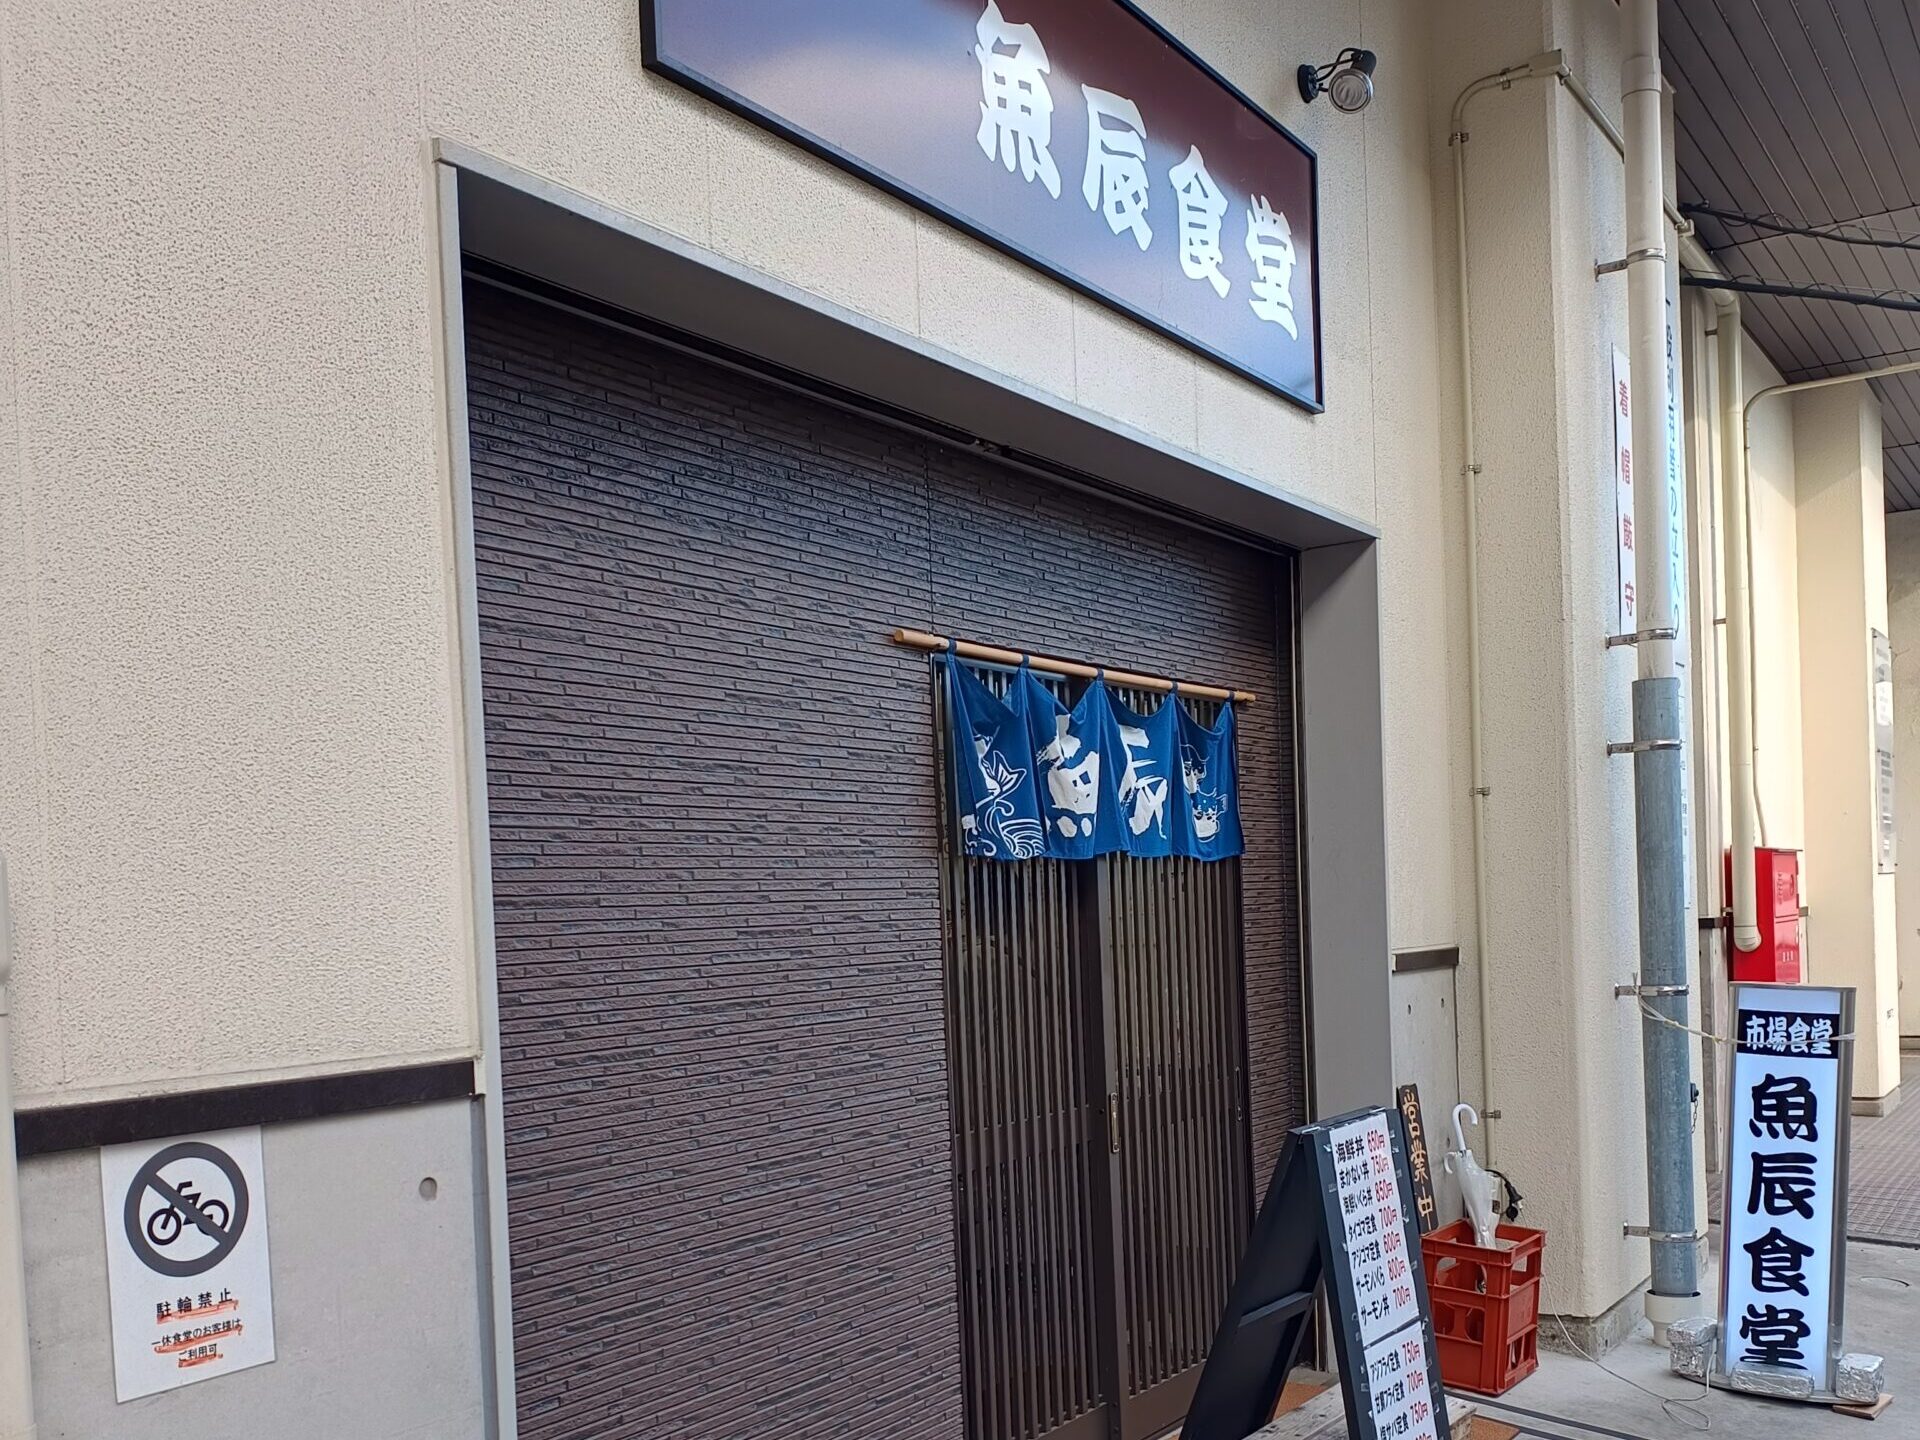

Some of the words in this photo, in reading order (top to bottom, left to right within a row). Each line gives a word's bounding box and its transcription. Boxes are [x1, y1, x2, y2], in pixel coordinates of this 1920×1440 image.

[975, 0, 1298, 340] 魚辰食堂
[1745, 1014, 1834, 1056] 市場食堂
[1335, 1135, 1364, 1164] 海鮮丼
[1367, 1129, 1385, 1152] 650円
[1403, 1089, 1433, 1231] 営業中
[1339, 1160, 1369, 1188] まかない丼
[1371, 1154, 1389, 1176] 750円
[1343, 1186, 1373, 1215] 海鮮いくら丼
[1375, 1179, 1393, 1202] 850円
[1349, 1213, 1377, 1242] タイゴマ定食
[1379, 1205, 1397, 1229] 700円
[1739, 1072, 1818, 1371] 魚辰食堂
[1352, 1239, 1381, 1269] アジゴマ定食
[1383, 1231, 1401, 1254] 600円
[1356, 1266, 1385, 1297] サーモンいくら
[1387, 1256, 1406, 1281] 800円
[157, 1288, 233, 1317] 駐輪禁止
[1361, 1294, 1390, 1326] サーモン丼
[1393, 1285, 1411, 1309] 700円
[151, 1318, 242, 1347] 一休食堂のお客様は
[178, 1343, 217, 1362] ご利用可
[1370, 1349, 1401, 1383] アジフライ定食
[1402, 1340, 1420, 1366] 750円
[1407, 1370, 1424, 1394] 700円
[1410, 1401, 1428, 1427] 750円
